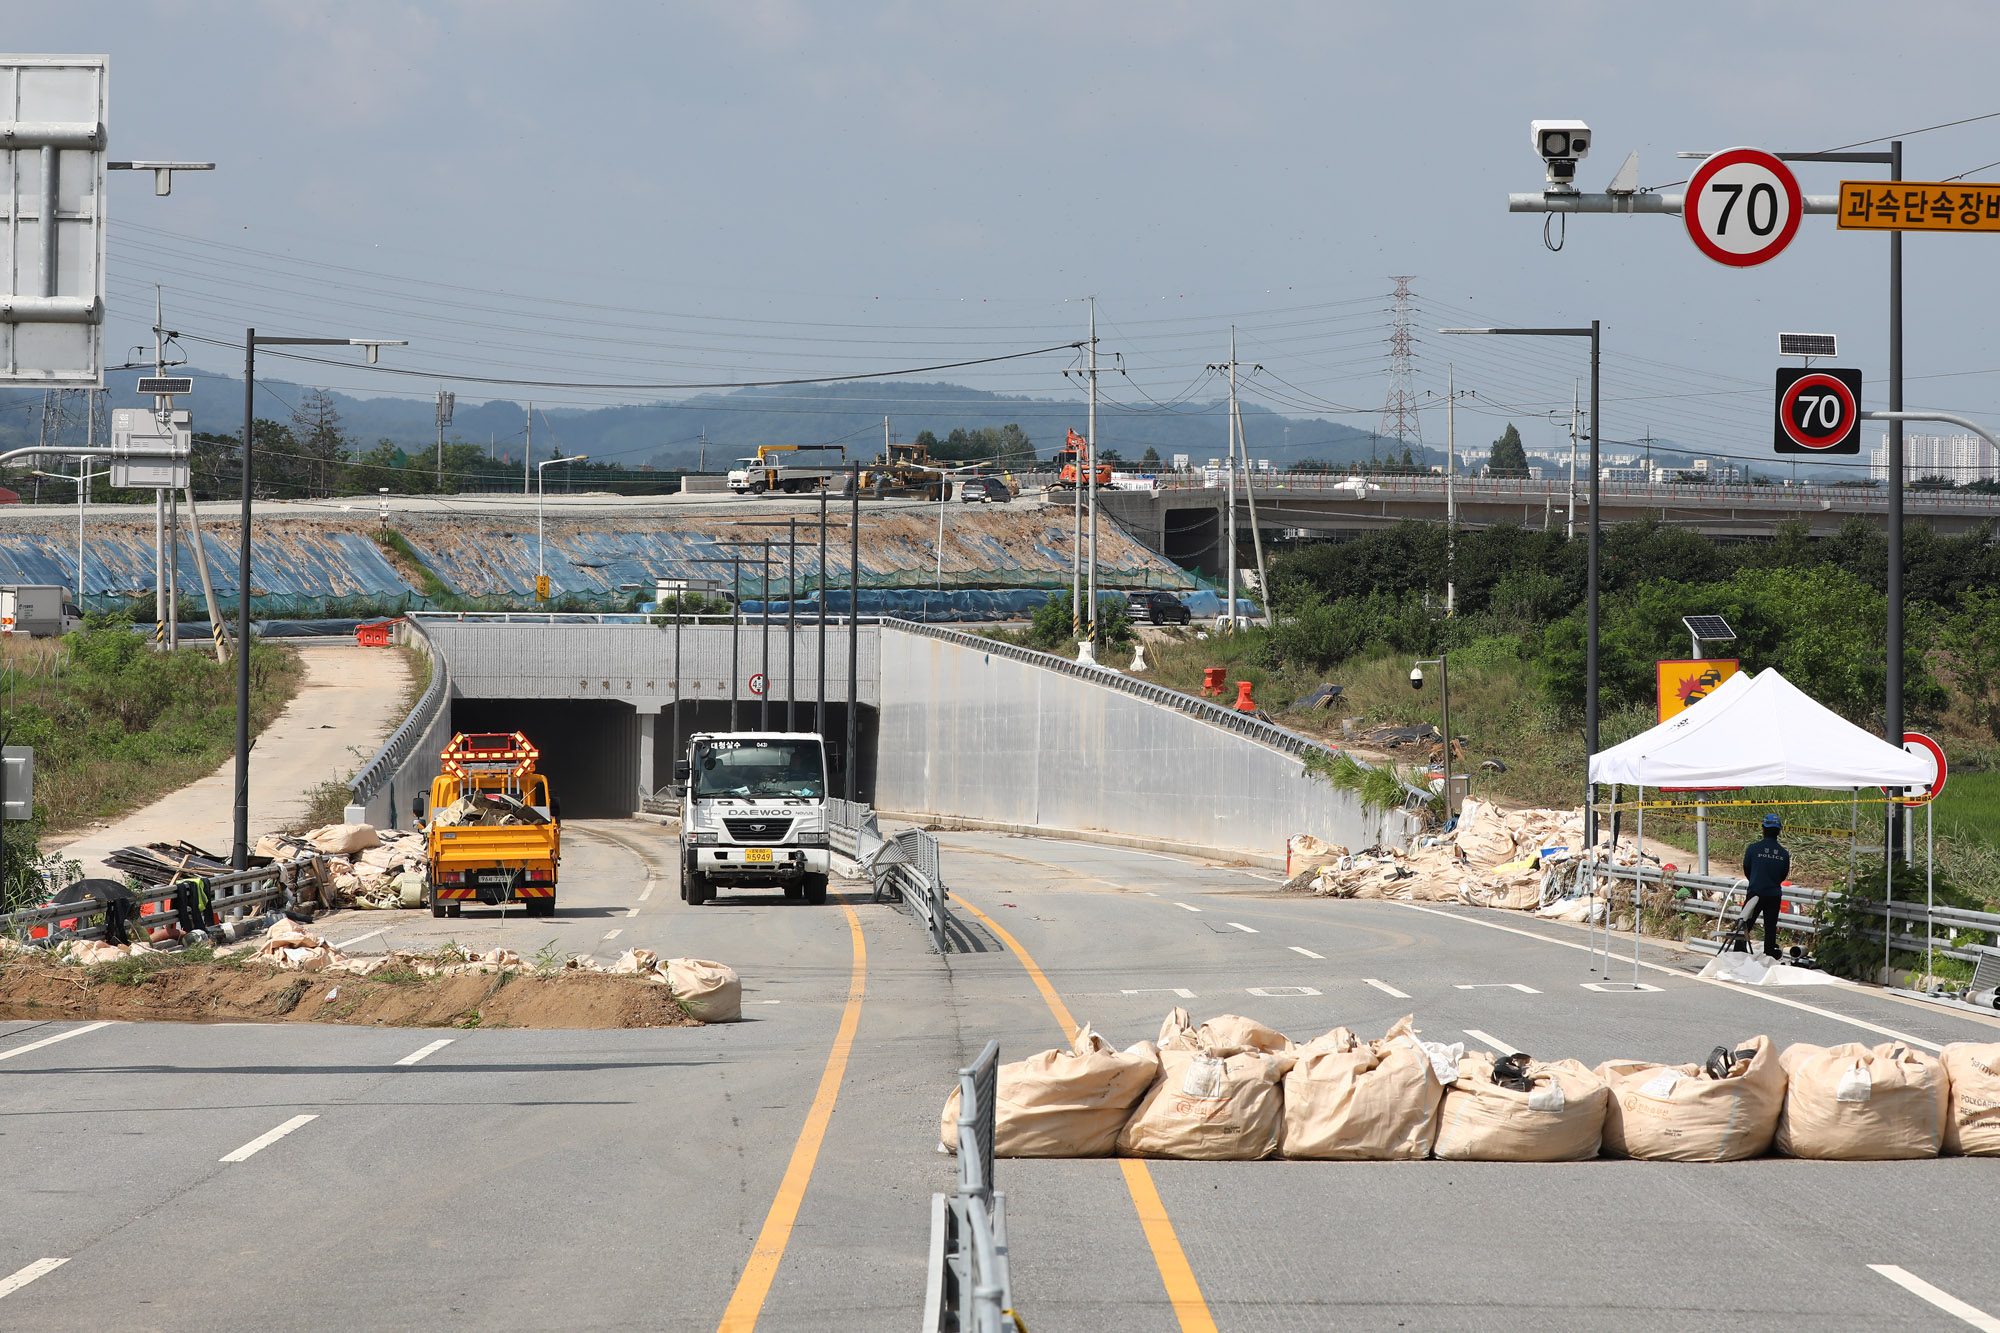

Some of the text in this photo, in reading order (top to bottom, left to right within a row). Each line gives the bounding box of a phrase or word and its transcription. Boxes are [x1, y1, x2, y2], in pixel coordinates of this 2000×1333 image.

[1712, 183, 1778, 236] 70
[1799, 395, 1840, 428] 70
[752, 853, 771, 861] 5949
[1757, 853, 1784, 861] POLICE
[1961, 1107, 1980, 1117] RESIN
